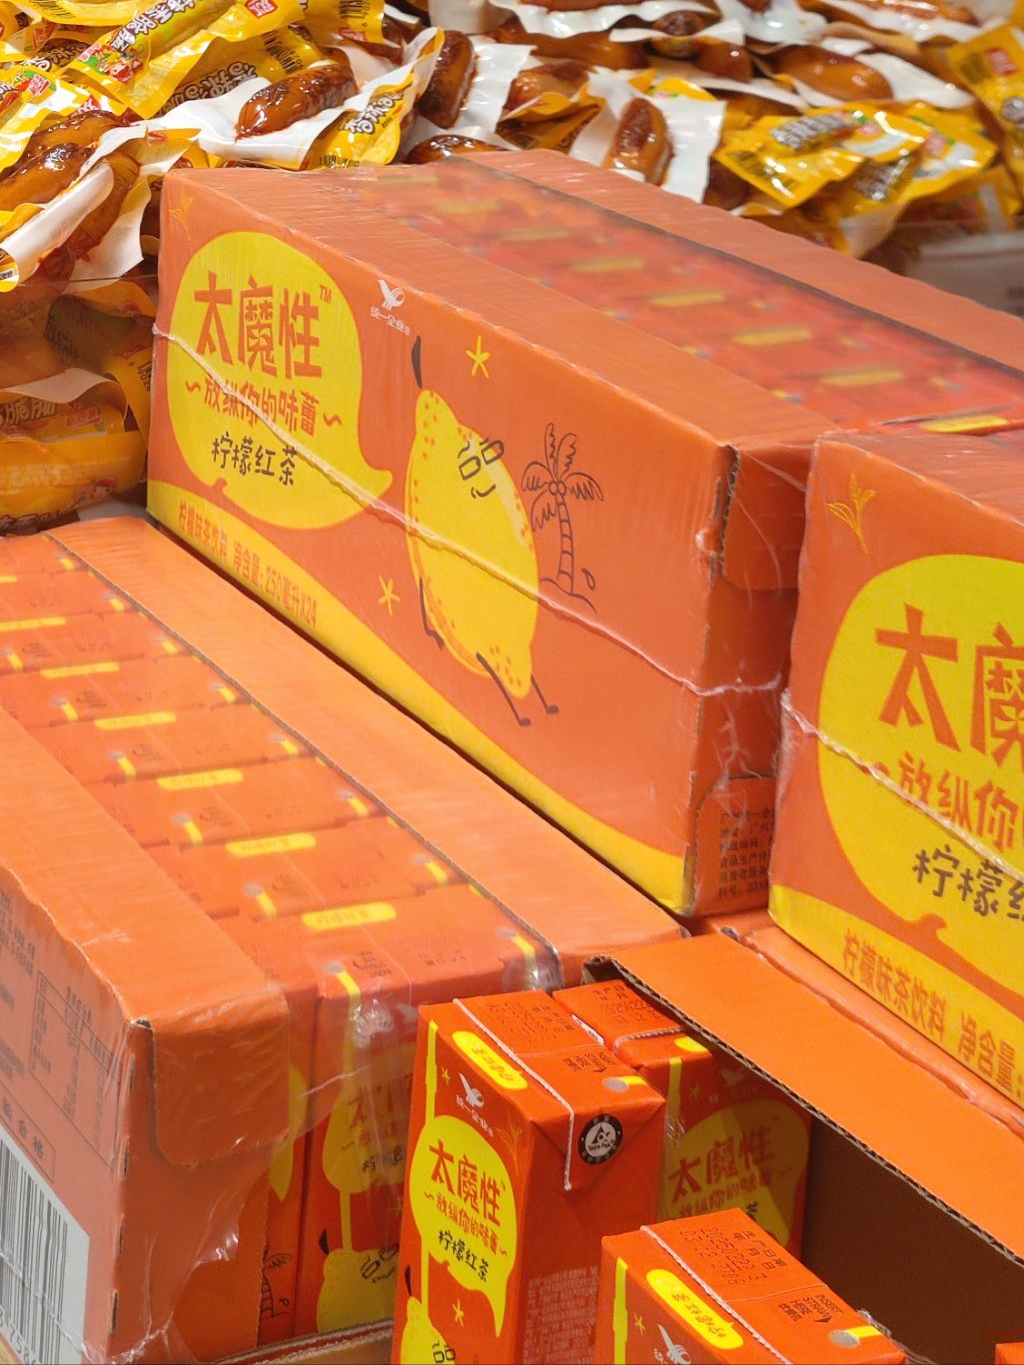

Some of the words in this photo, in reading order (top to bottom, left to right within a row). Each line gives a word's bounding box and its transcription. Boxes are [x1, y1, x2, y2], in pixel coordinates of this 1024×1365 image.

[193, 270, 323, 381] 太魔性
[211, 431, 299, 487] 柠檬红茶
[842, 927, 949, 1040] 柠檬味茶饮料
[428, 1139, 501, 1228] 太魔性
[667, 1124, 774, 1205] 太魔性
[438, 1227, 490, 1284] 柠檬红茶
